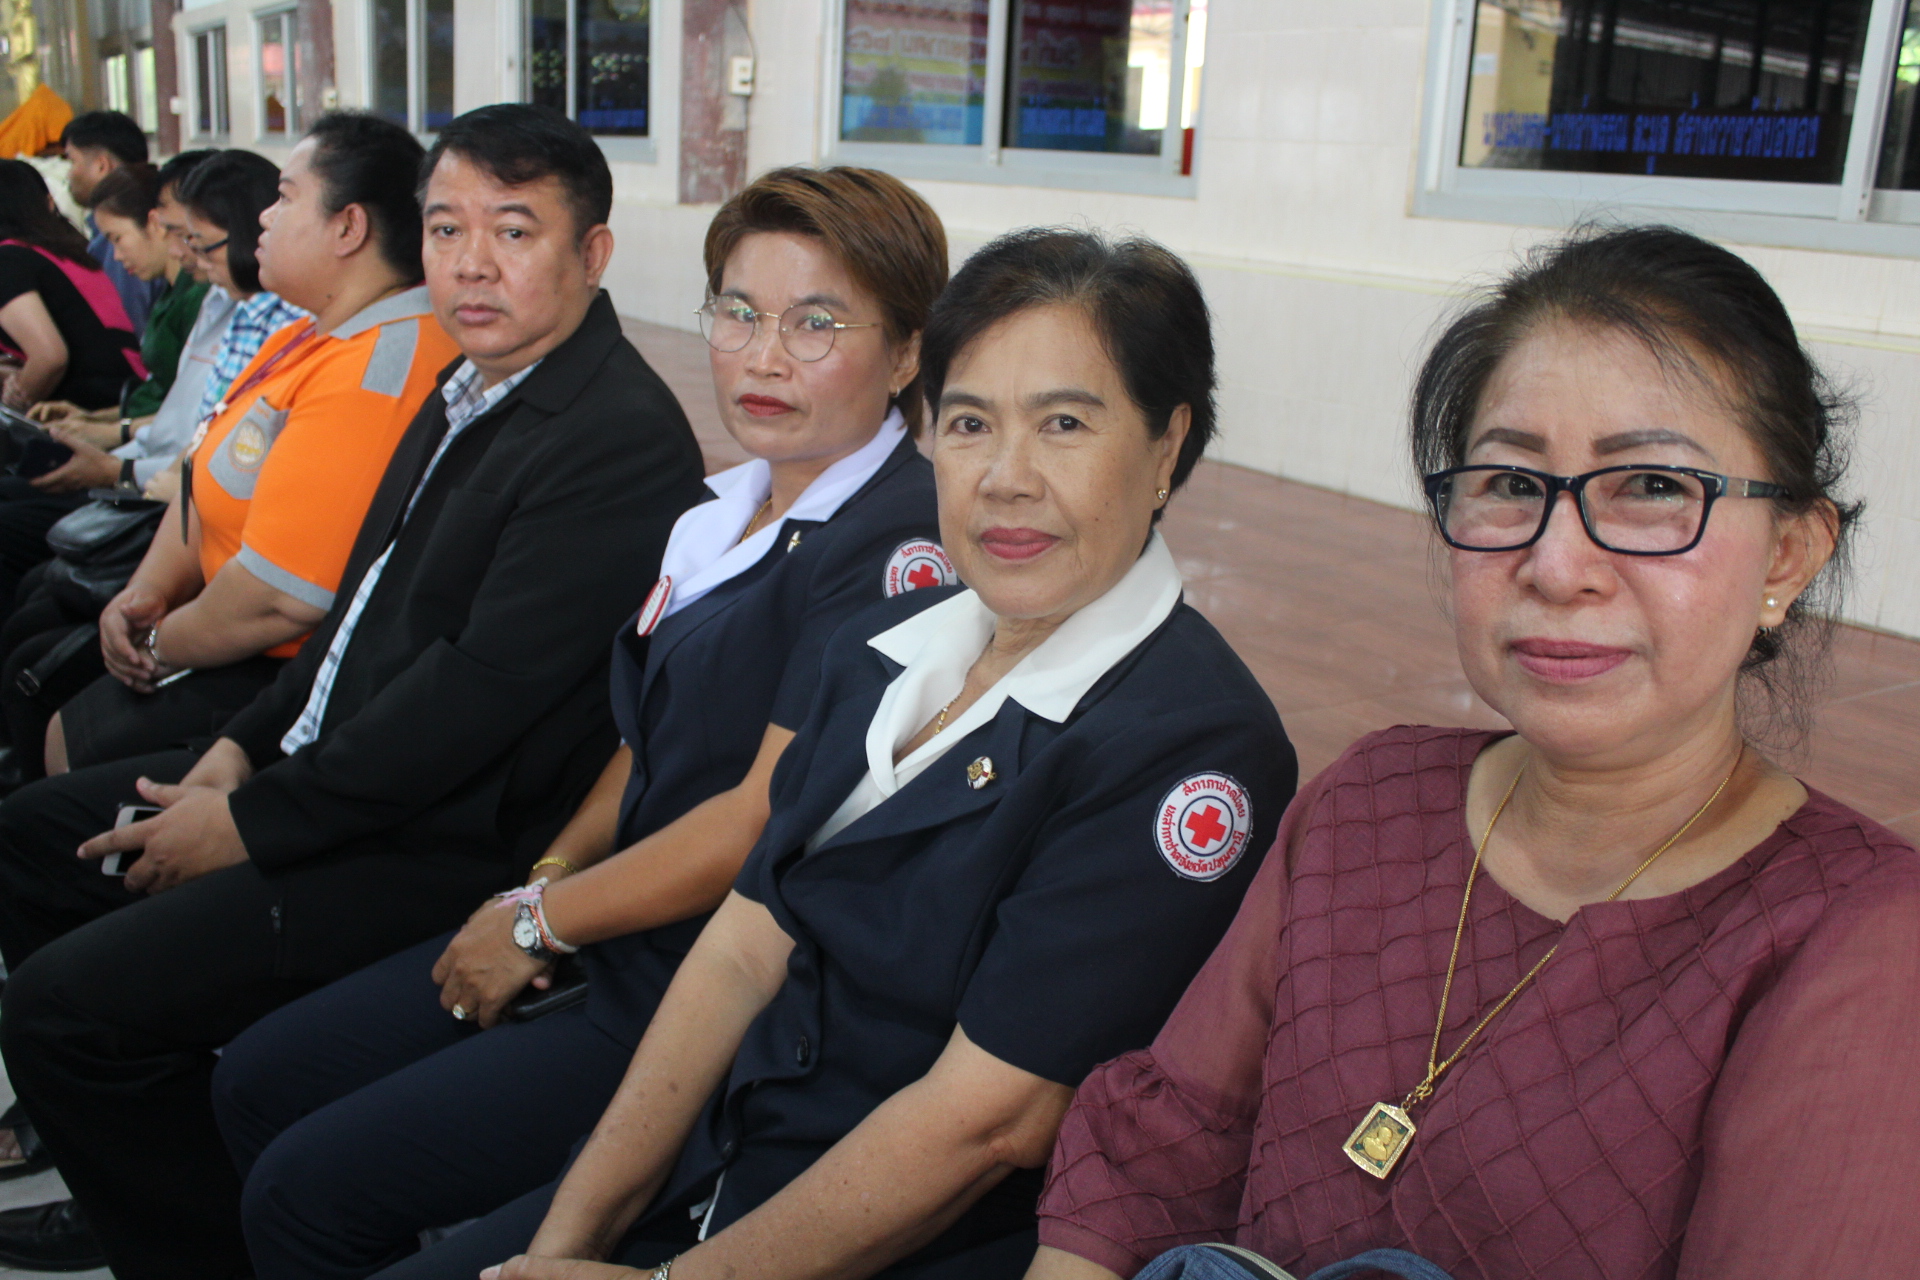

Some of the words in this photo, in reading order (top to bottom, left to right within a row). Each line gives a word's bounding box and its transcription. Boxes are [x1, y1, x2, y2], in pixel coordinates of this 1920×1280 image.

[1182, 778, 1245, 818] สภากาชาดไทย
[1161, 804, 1246, 873] เหล่ากาชาดจังหวัดปทุมธานี
